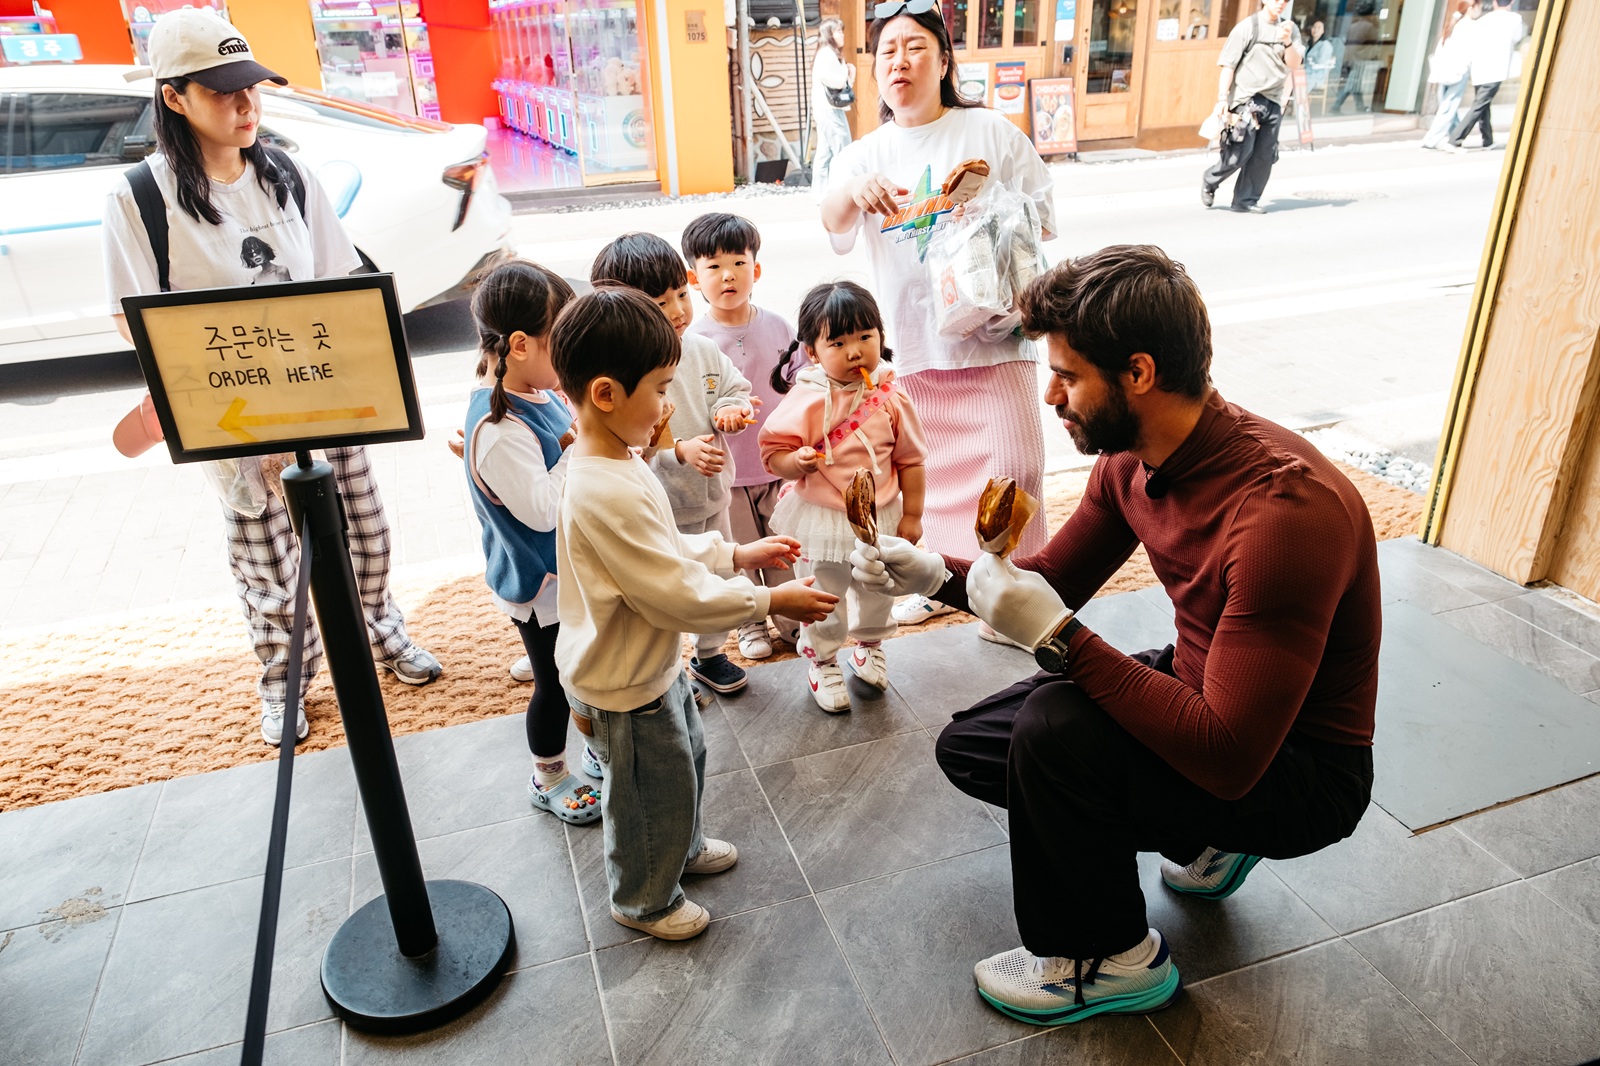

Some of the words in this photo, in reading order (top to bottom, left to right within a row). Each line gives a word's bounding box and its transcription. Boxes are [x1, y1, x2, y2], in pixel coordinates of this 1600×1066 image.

[688, 32, 706, 41] 1075
[204, 325, 295, 361] 주문하는
[311, 322, 332, 351] 곳
[208, 367, 271, 388] ORDER
[286, 362, 334, 383] HERE
